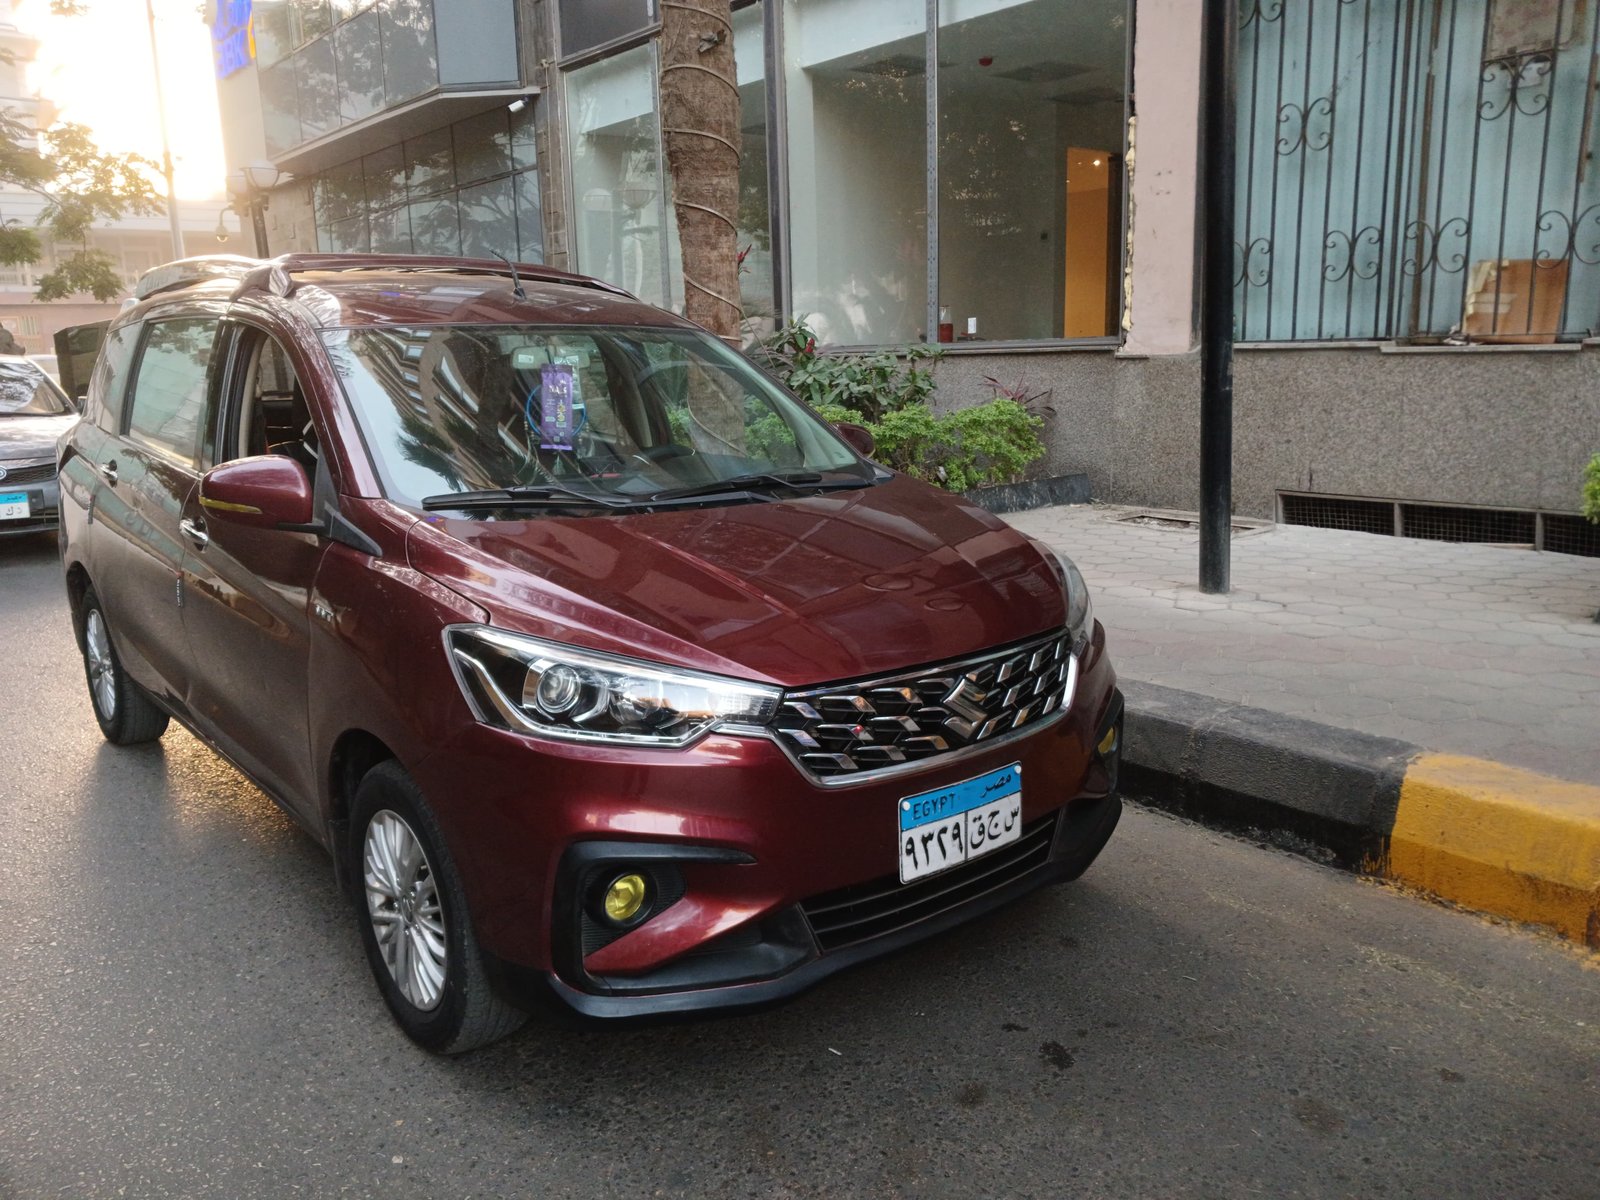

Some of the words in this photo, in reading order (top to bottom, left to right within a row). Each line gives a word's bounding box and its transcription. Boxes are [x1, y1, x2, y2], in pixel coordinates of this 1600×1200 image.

[981, 773, 1012, 799] مصر
[913, 792, 957, 820] EGYPT
[905, 821, 963, 870] ٩٣٢٩
